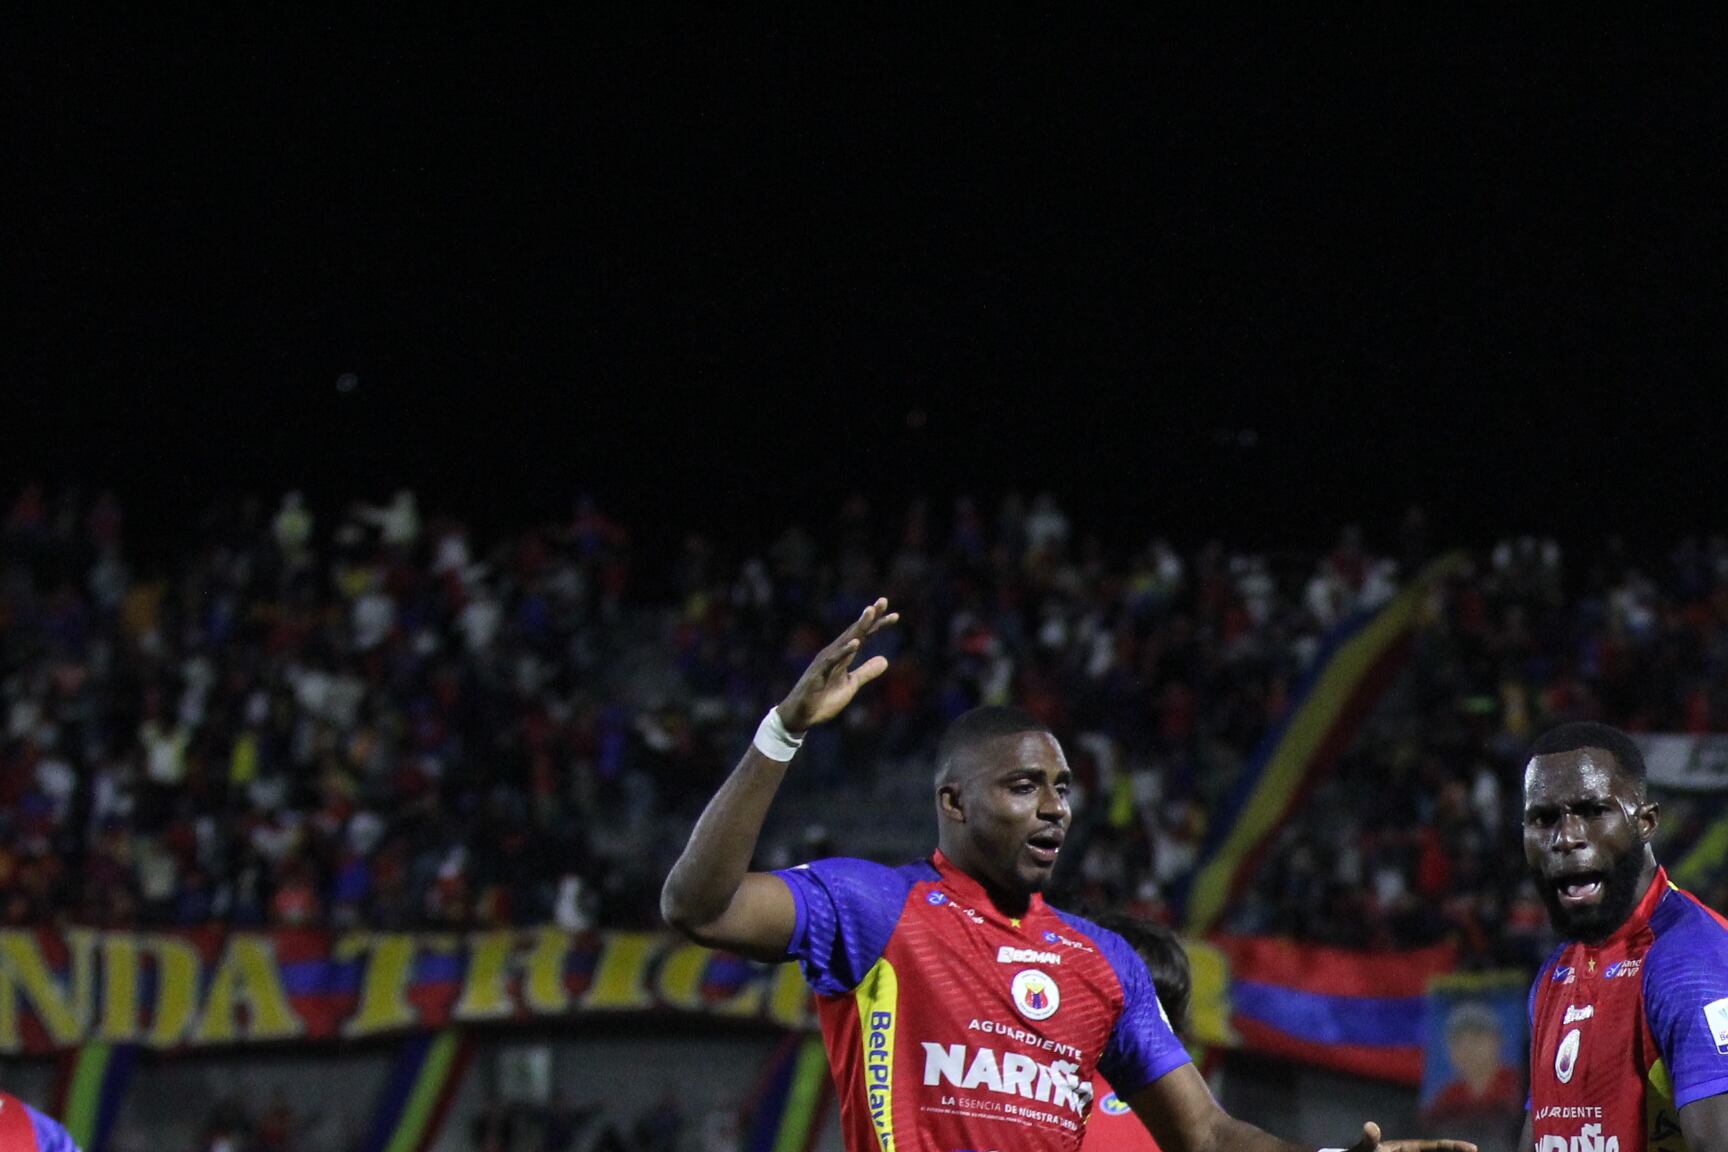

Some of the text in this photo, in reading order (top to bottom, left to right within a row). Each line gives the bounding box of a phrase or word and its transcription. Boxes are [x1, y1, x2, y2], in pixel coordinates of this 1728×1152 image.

[968, 1018, 1083, 1061] AGUARDIENTE
[941, 1096, 957, 1106] LA
[958, 1097, 1001, 1111] ESENCIA
[1004, 1103, 1018, 1114] DE
[1018, 1107, 1059, 1125] NUESTRA
